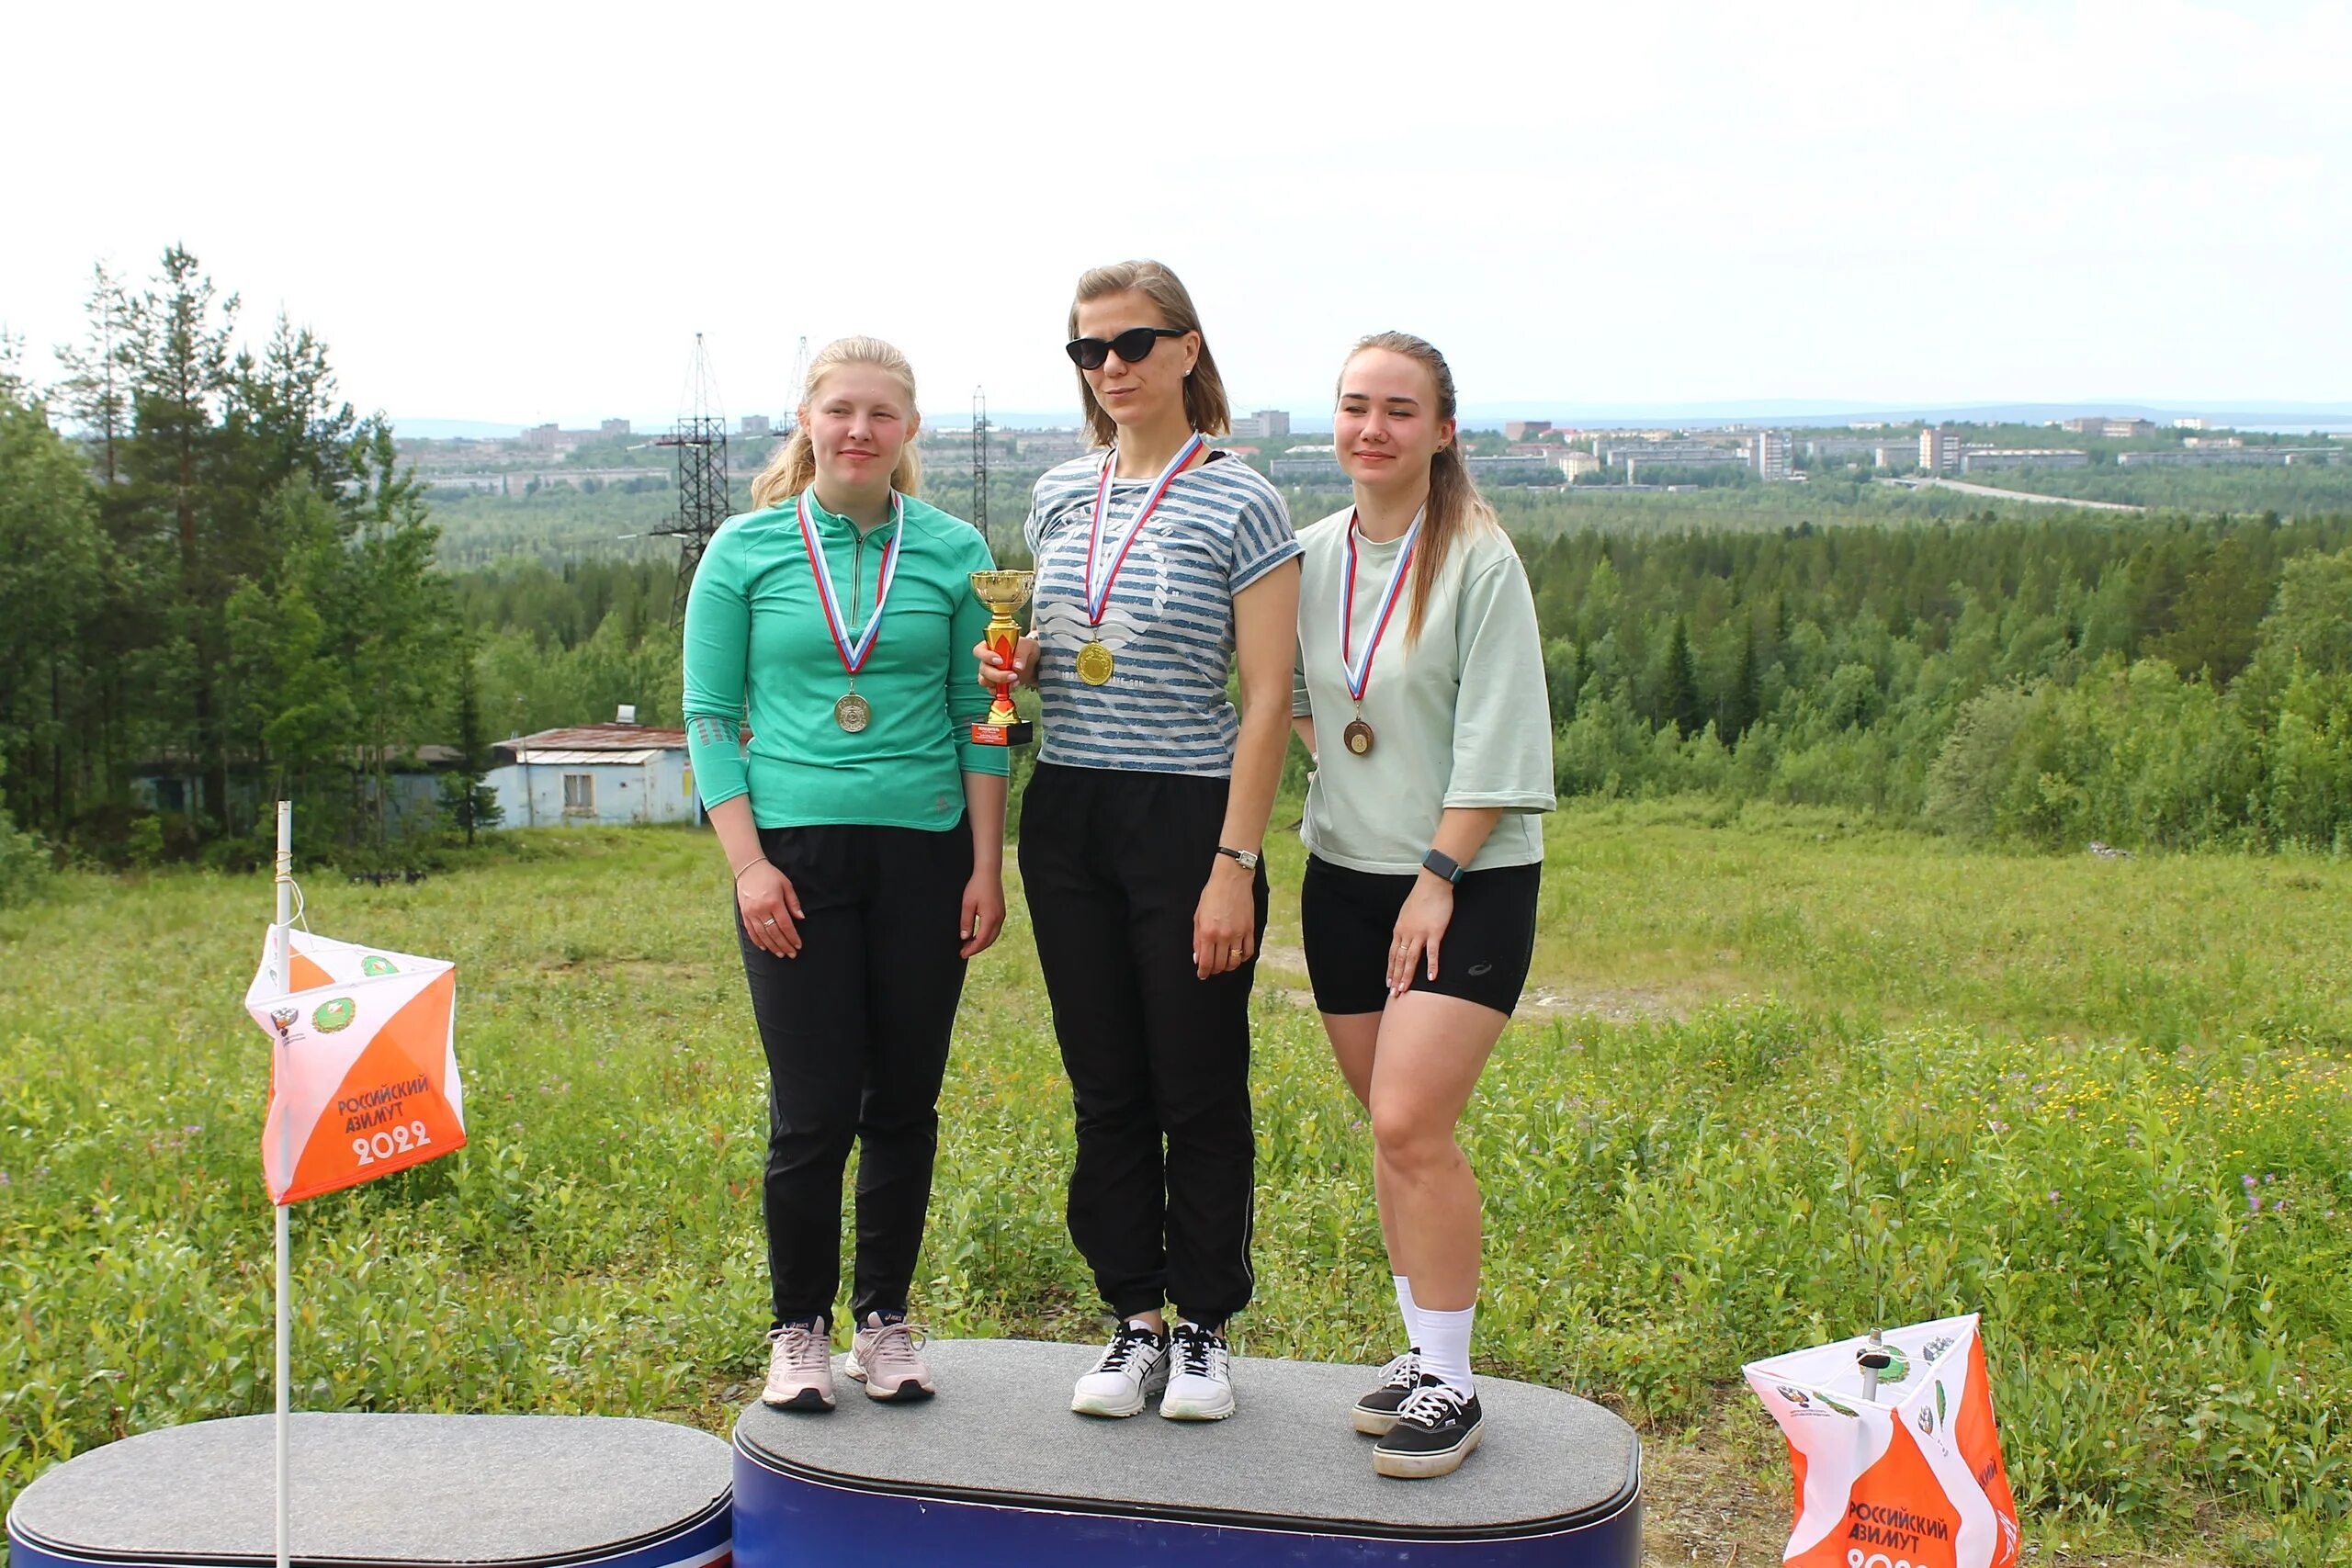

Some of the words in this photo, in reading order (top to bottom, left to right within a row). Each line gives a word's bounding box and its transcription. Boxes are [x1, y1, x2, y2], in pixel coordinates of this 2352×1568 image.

[337, 1073, 429, 1116] РОССИЙСКИЙ
[345, 1101, 403, 1134] АЗИМУТ
[352, 1120, 432, 1167] 2022
[1849, 1500, 1948, 1541] РОССИЙСКИЙ
[1849, 1522, 1919, 1554] АЗИМУТ
